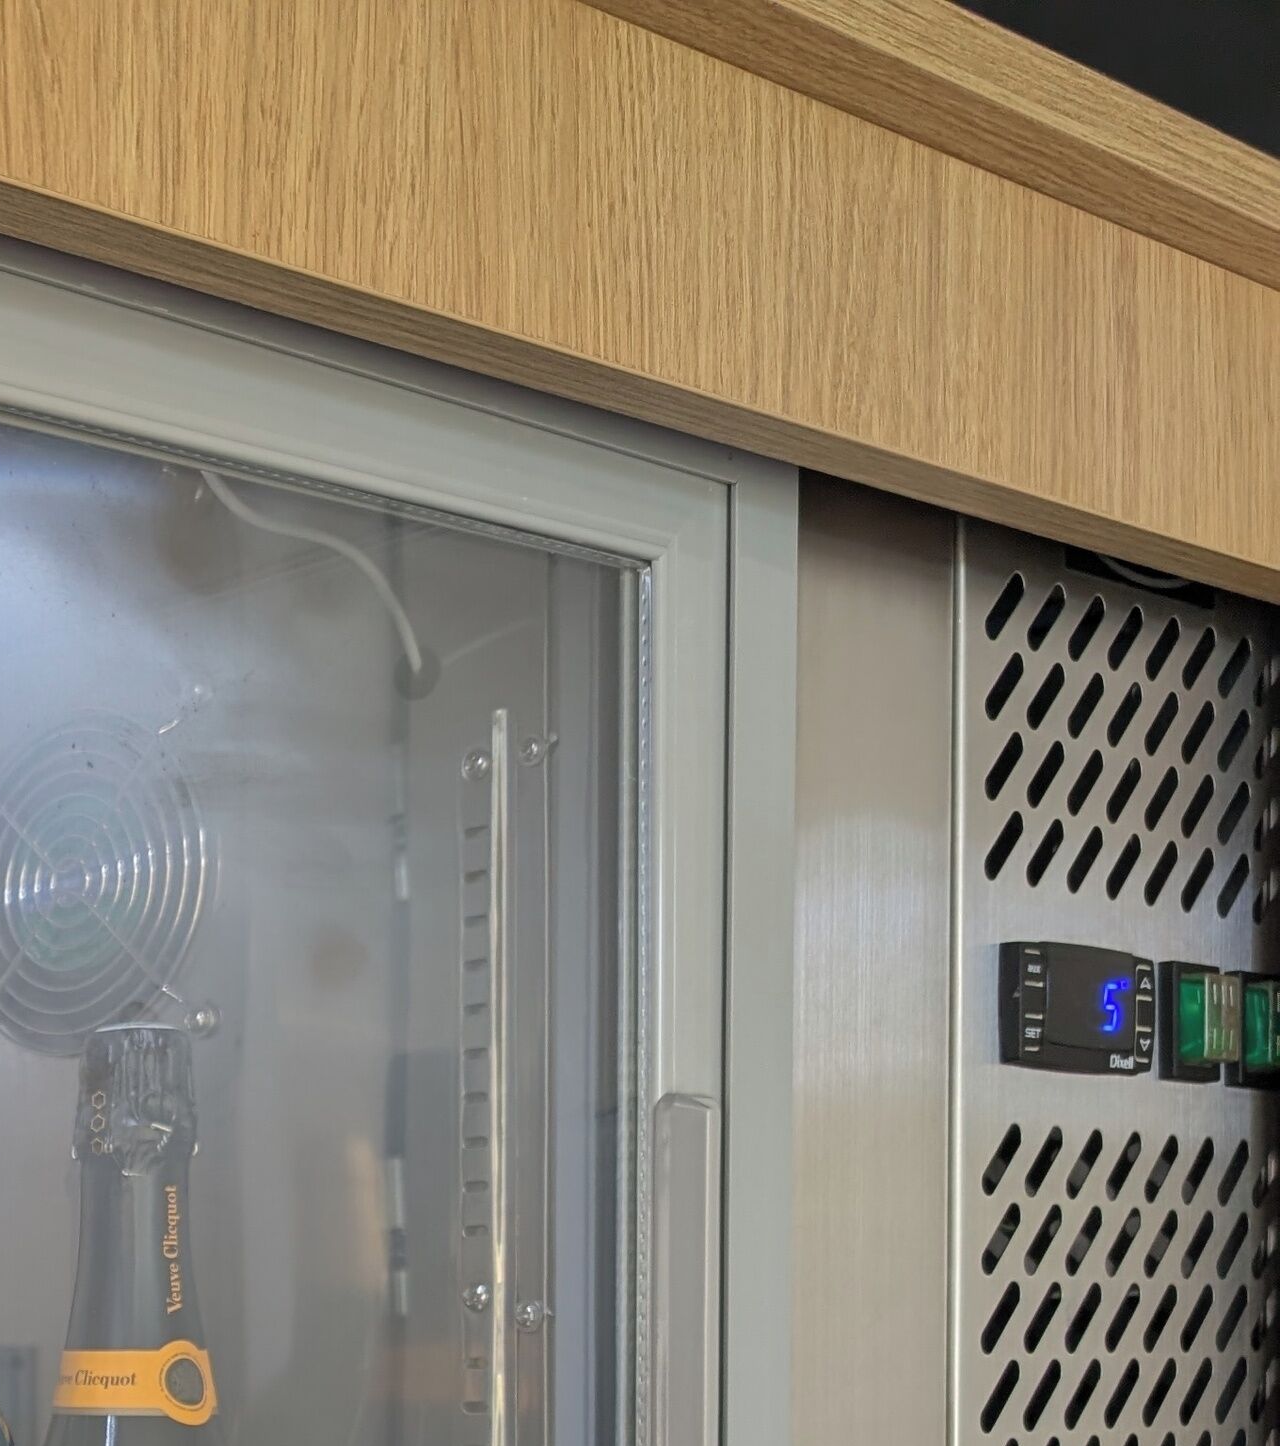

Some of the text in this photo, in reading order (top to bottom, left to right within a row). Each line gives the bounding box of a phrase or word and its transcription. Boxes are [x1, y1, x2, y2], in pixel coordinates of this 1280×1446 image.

[1025, 1027, 1041, 1039] SET
[163, 1184, 182, 1314] Veuve Clicquot
[75, 1369, 136, 1390] Clicquot
